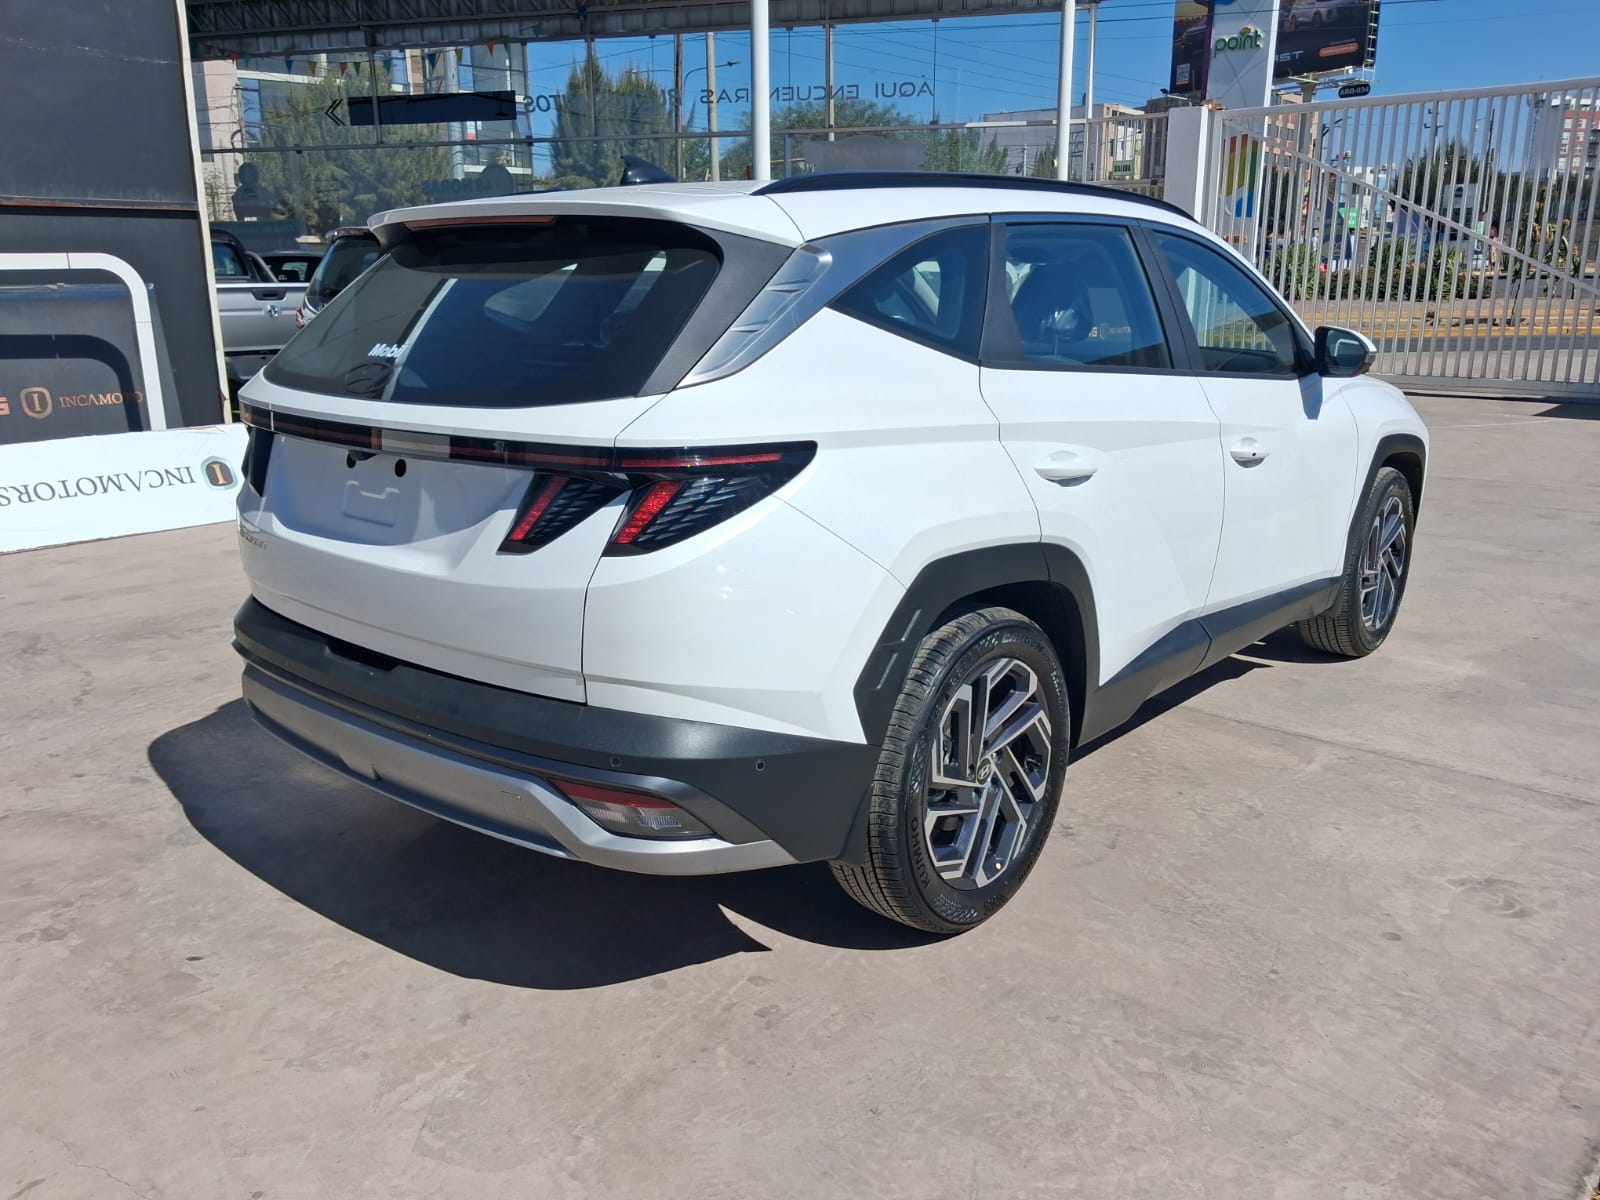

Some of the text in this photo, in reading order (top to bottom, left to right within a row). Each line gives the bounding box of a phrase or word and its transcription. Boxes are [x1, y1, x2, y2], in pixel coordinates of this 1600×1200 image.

[1214, 27, 1262, 58] point
[1275, 50, 1304, 62] ST
[0, 466, 196, 506] INCAMOTORS
[911, 816, 930, 889] KUMHO
